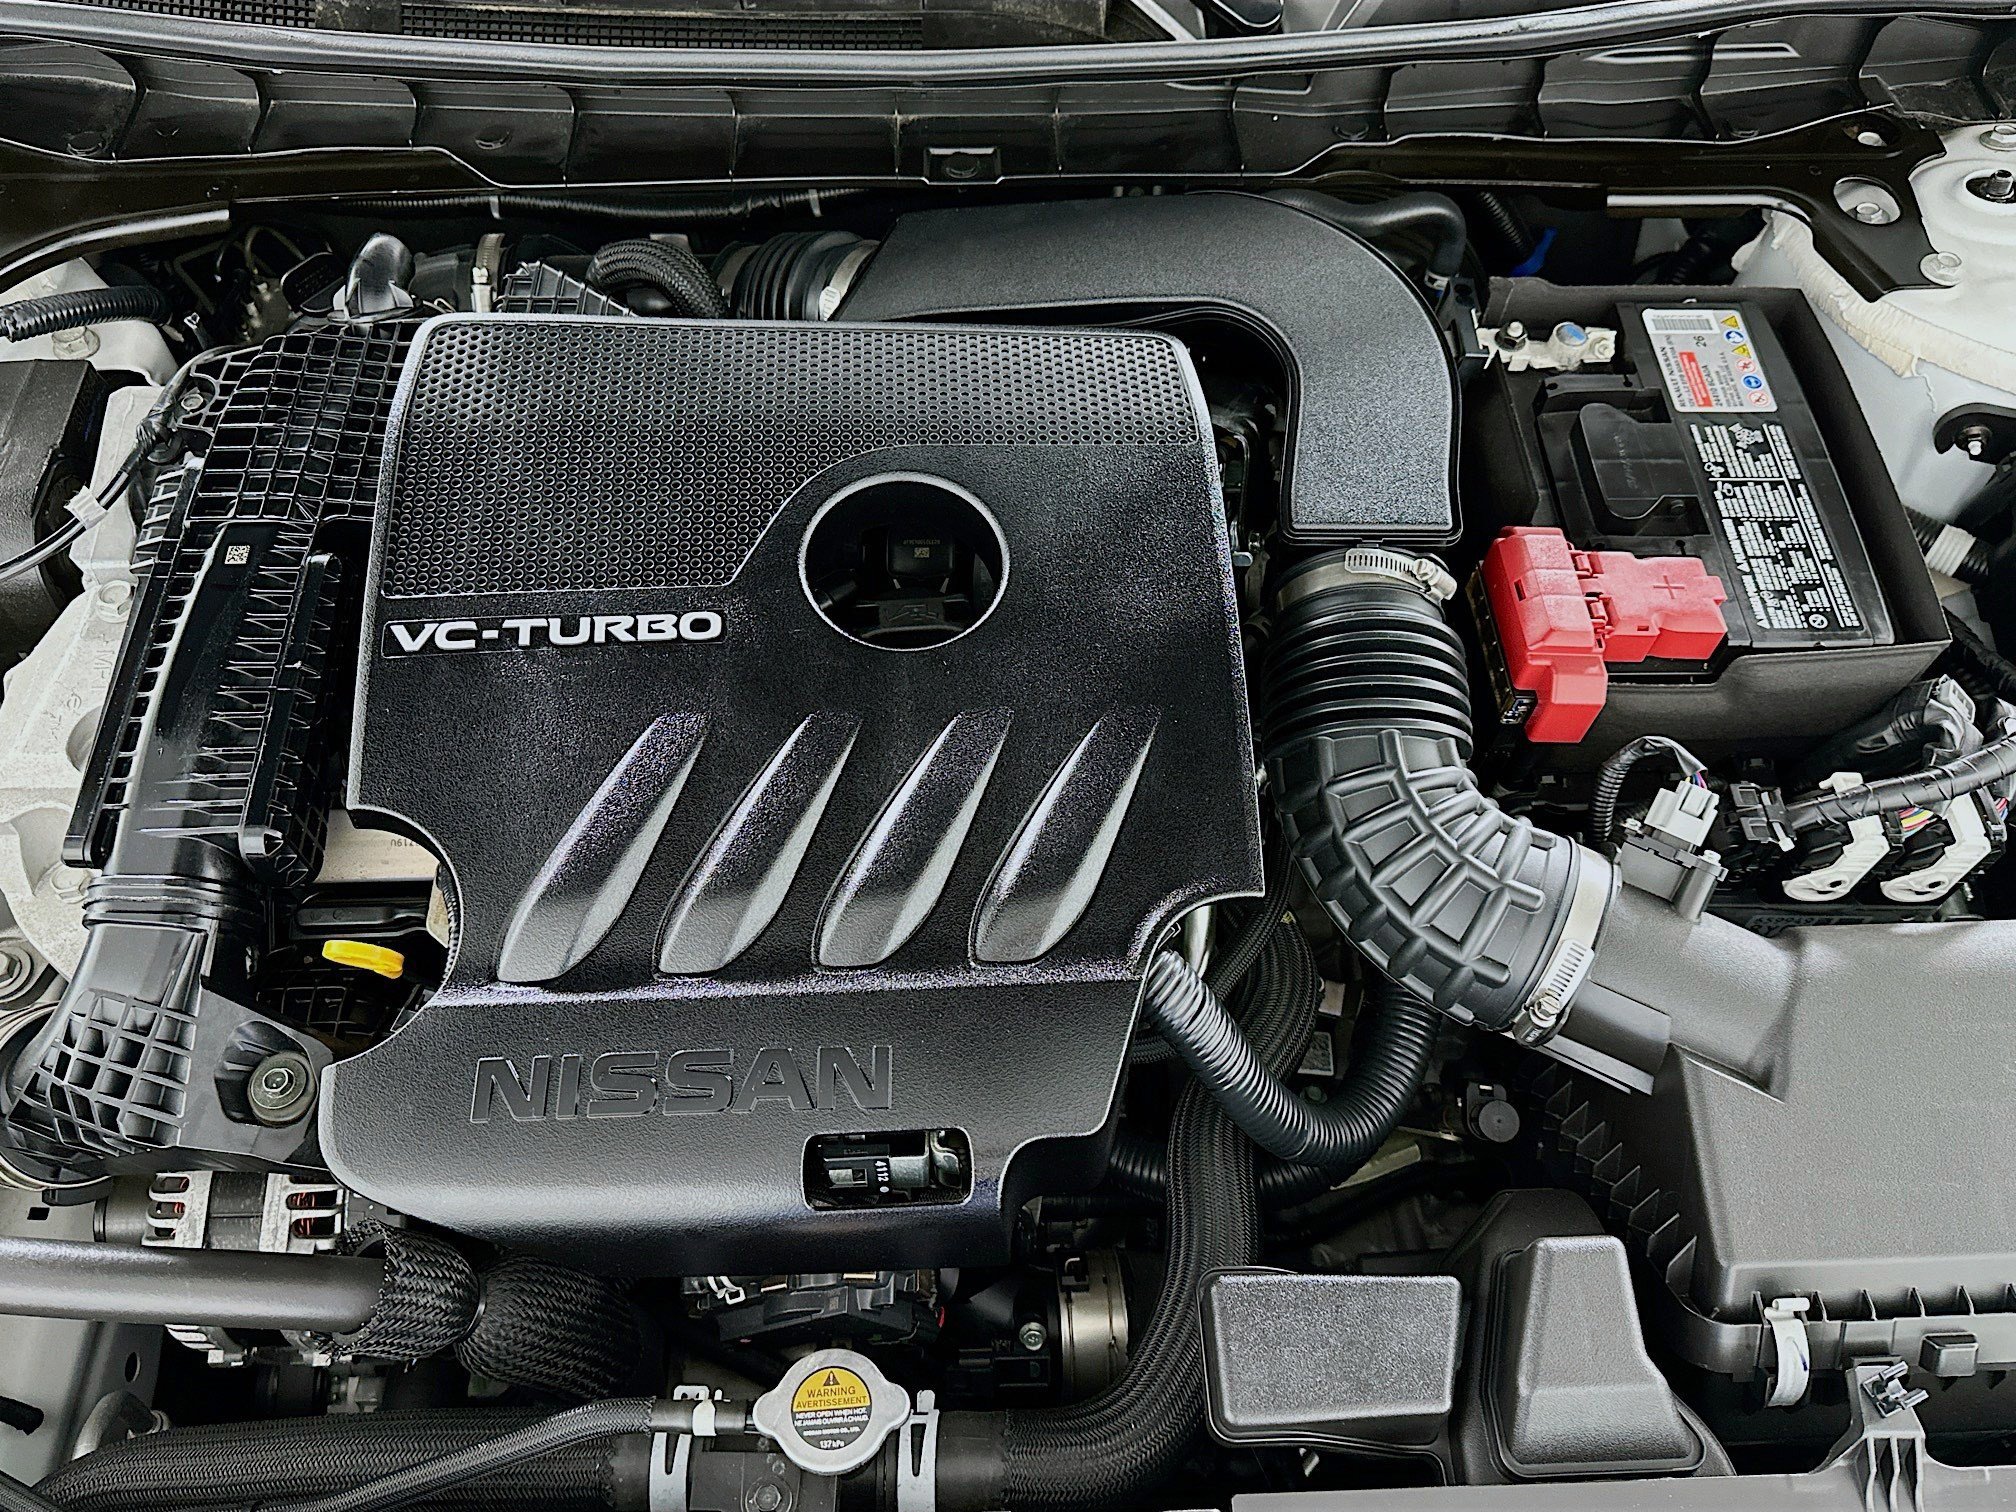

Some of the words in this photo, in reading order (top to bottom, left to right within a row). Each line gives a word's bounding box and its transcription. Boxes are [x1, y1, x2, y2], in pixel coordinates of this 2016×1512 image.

[1693, 335, 1707, 347] 26
[1660, 346, 1675, 376] NISSAN
[1671, 378, 1686, 407] RENAULT
[390, 611, 722, 652] VC-TURBO
[470, 1045, 892, 1124] NISSAN
[807, 1386, 856, 1398] WARNING
[796, 1395, 867, 1409] AVERTISSEMENT
[795, 1411, 816, 1420] NEVER
[816, 1410, 833, 1418] OPEN
[834, 1408, 853, 1416] WHEN
[820, 1440, 832, 1449] 137
